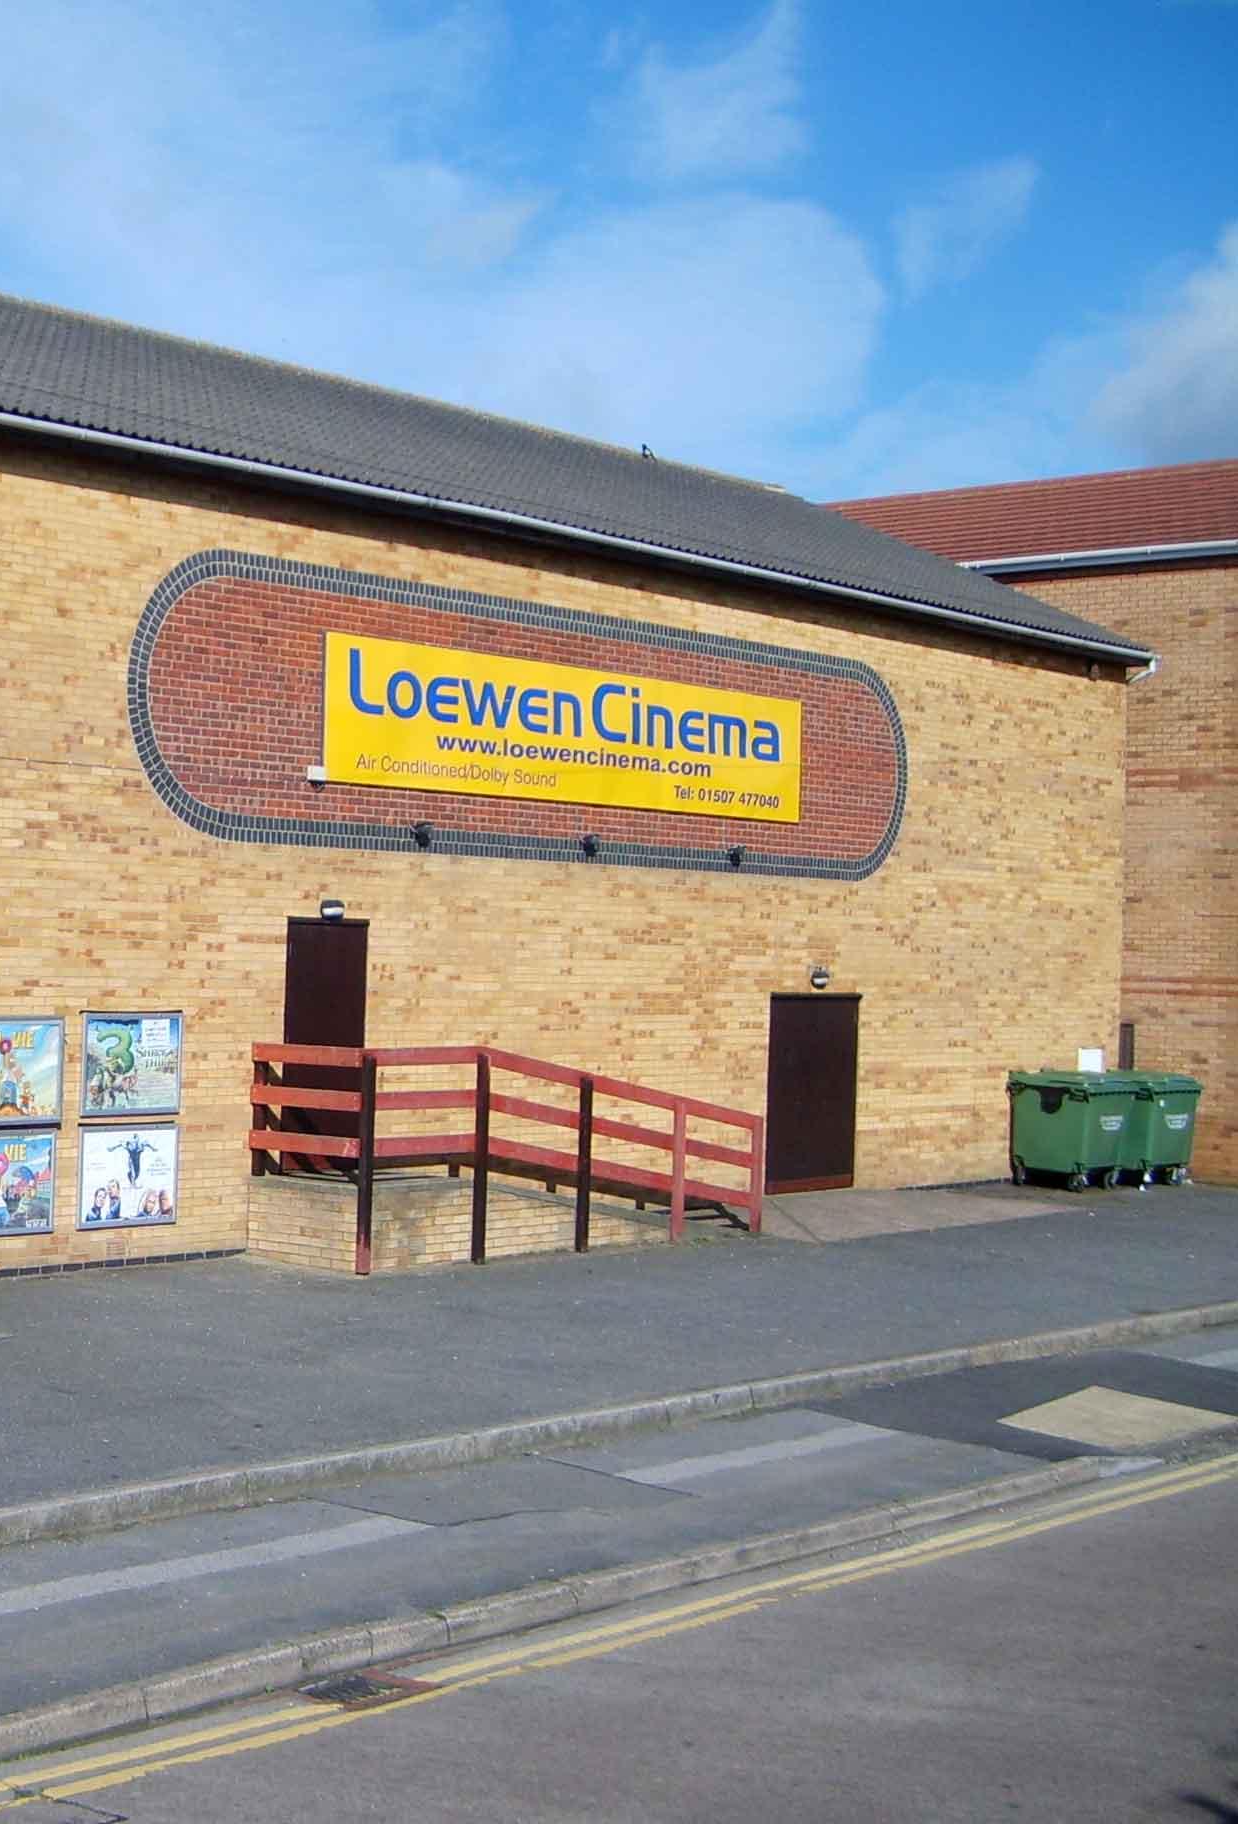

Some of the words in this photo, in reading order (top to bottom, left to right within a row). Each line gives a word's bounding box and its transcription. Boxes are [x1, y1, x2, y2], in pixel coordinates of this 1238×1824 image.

[356, 753, 377, 770] Air
[381, 755, 510, 785] Conditioned/Dolby
[513, 767, 557, 788] Sound
[436, 735, 712, 778] www.loewencinema.com
[674, 785, 694, 801] Tel:
[697, 788, 735, 804] 01507
[738, 792, 780, 809] 477040
